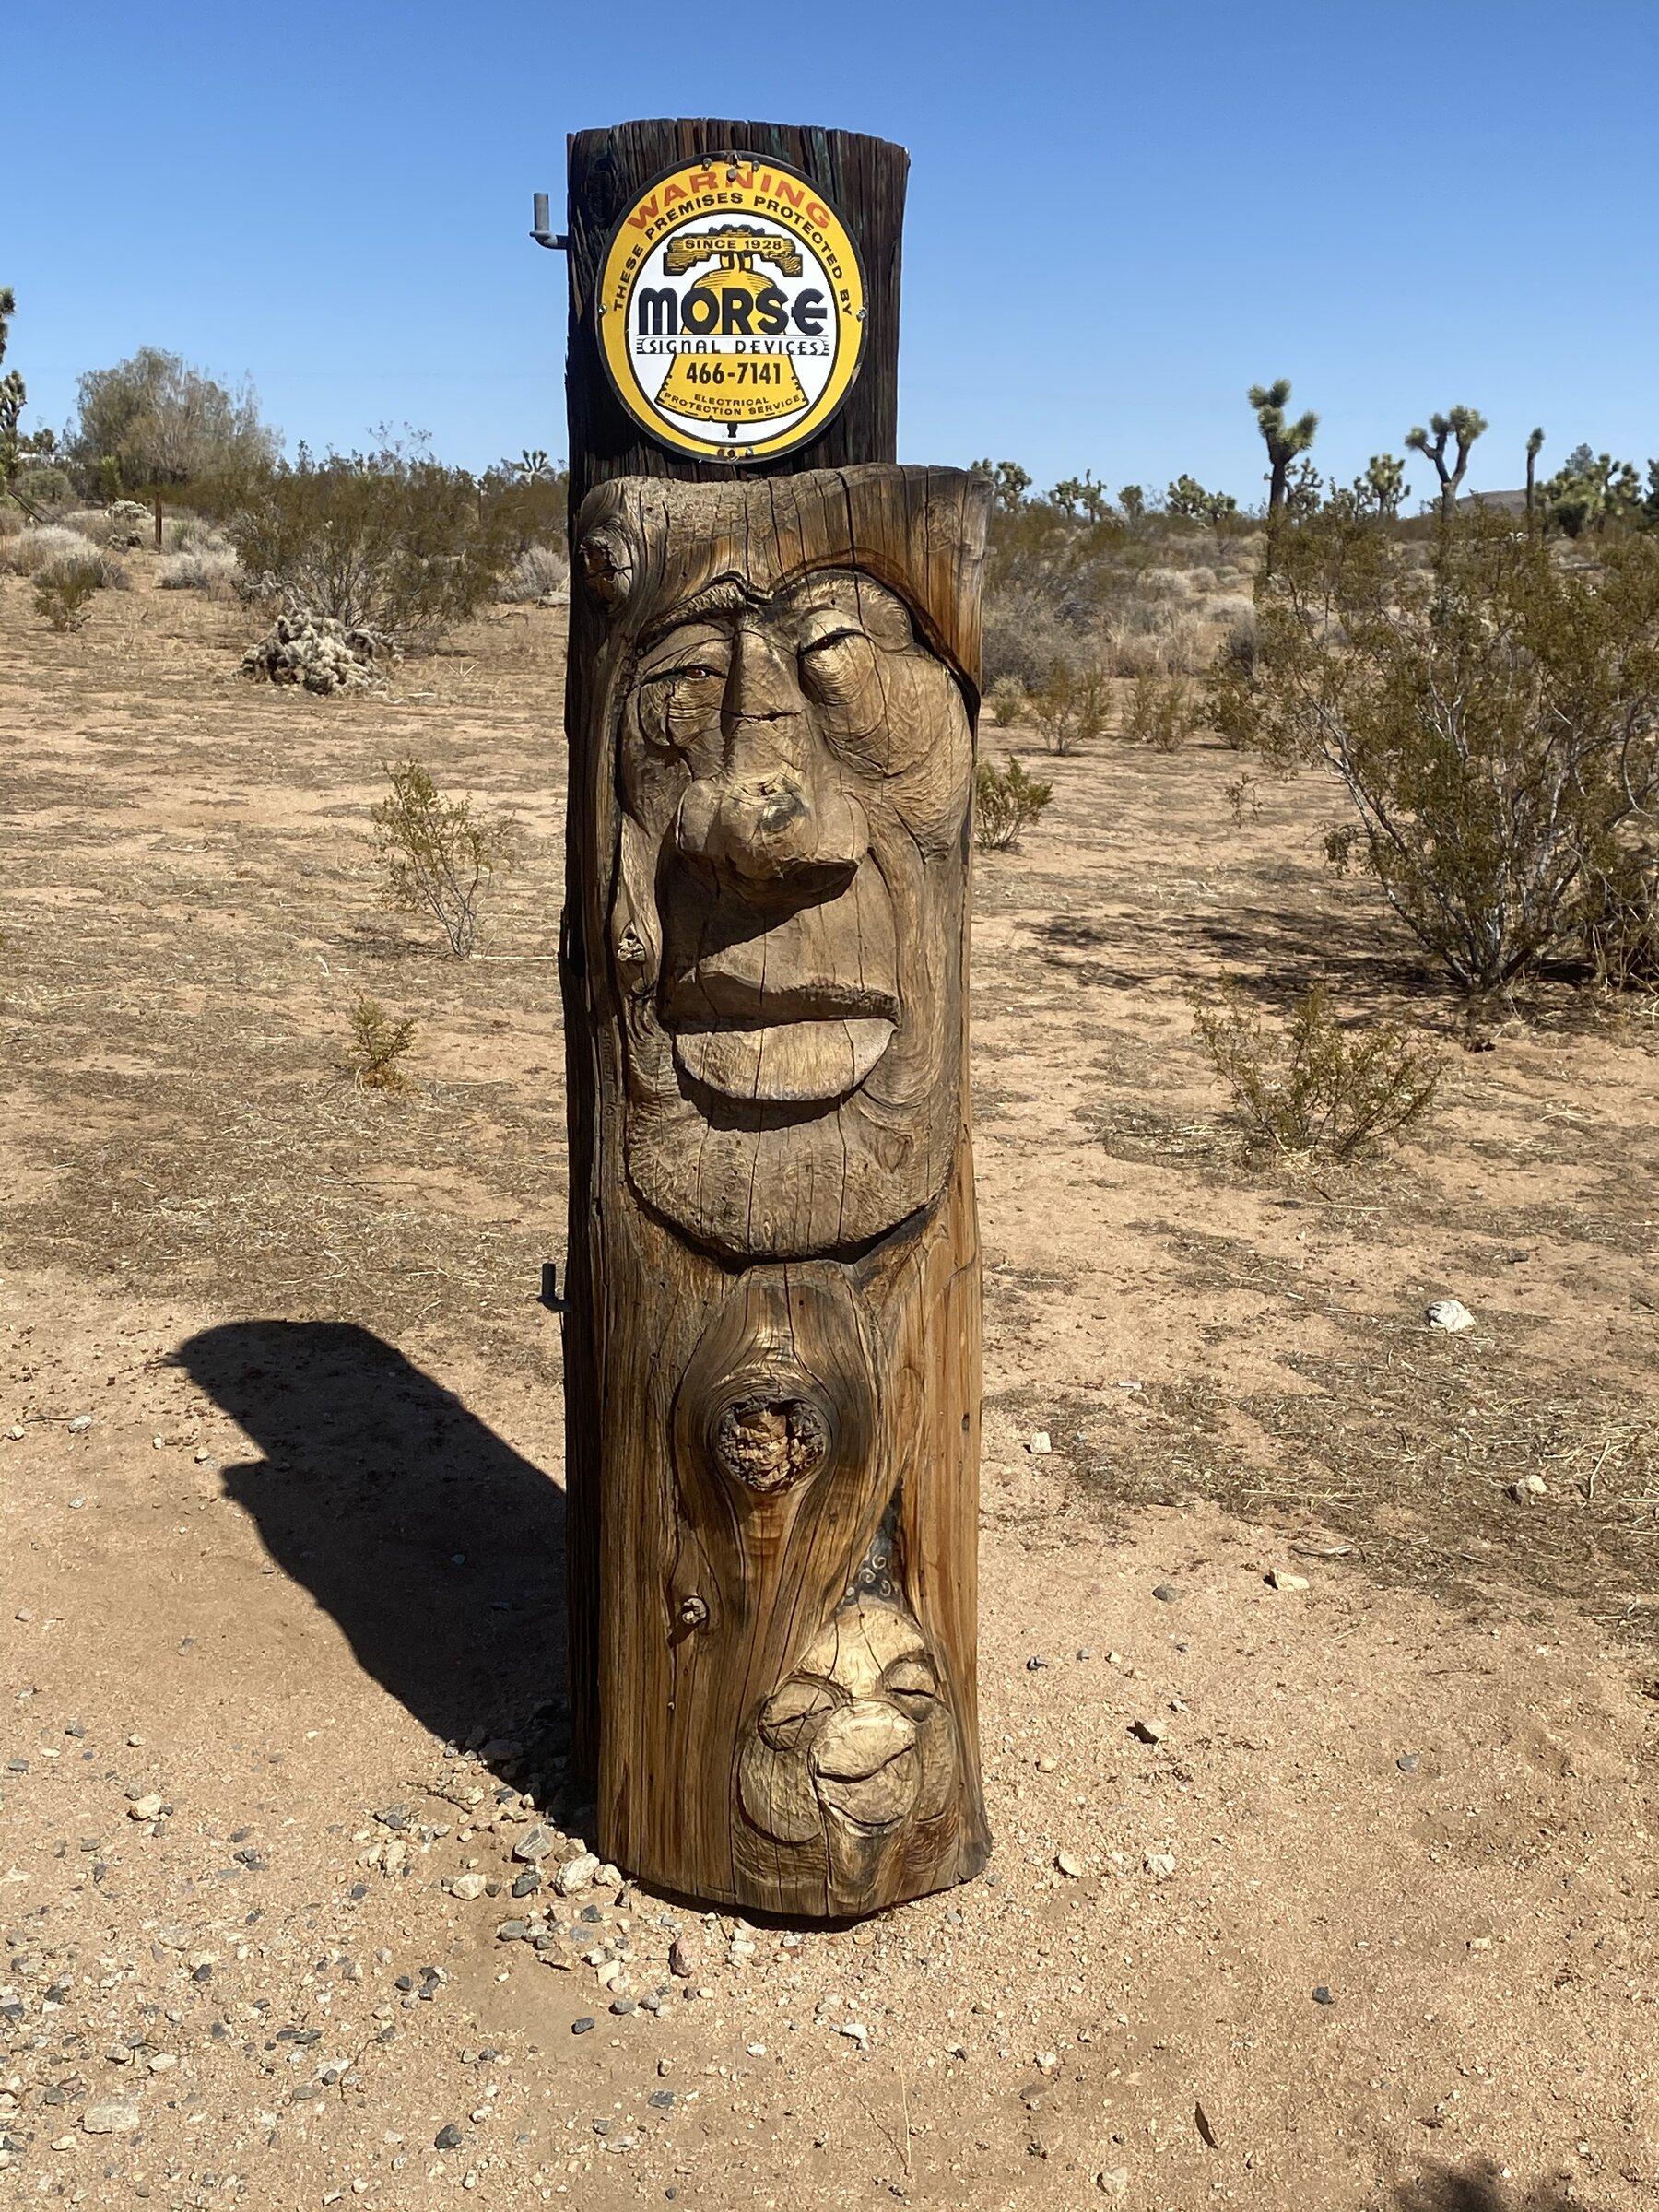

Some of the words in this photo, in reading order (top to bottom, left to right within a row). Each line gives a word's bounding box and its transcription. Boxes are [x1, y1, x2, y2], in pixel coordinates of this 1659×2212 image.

[628, 171, 831, 230] WARNING
[614, 247, 644, 311] THESE
[645, 192, 744, 240] PREMISES
[754, 195, 843, 280] PROTECTED
[839, 288, 853, 316] BY
[685, 238, 736, 250] SINCE
[744, 238, 783, 251] 1928
[638, 287, 828, 336] MORSE
[649, 339, 720, 355] SIGNAL
[735, 339, 818, 356] DEVICES
[686, 362, 782, 385] 466-7141
[664, 392, 742, 416] PROTECTION
[748, 394, 800, 415] SERVICE
[693, 394, 770, 406] ELECTRICAL
